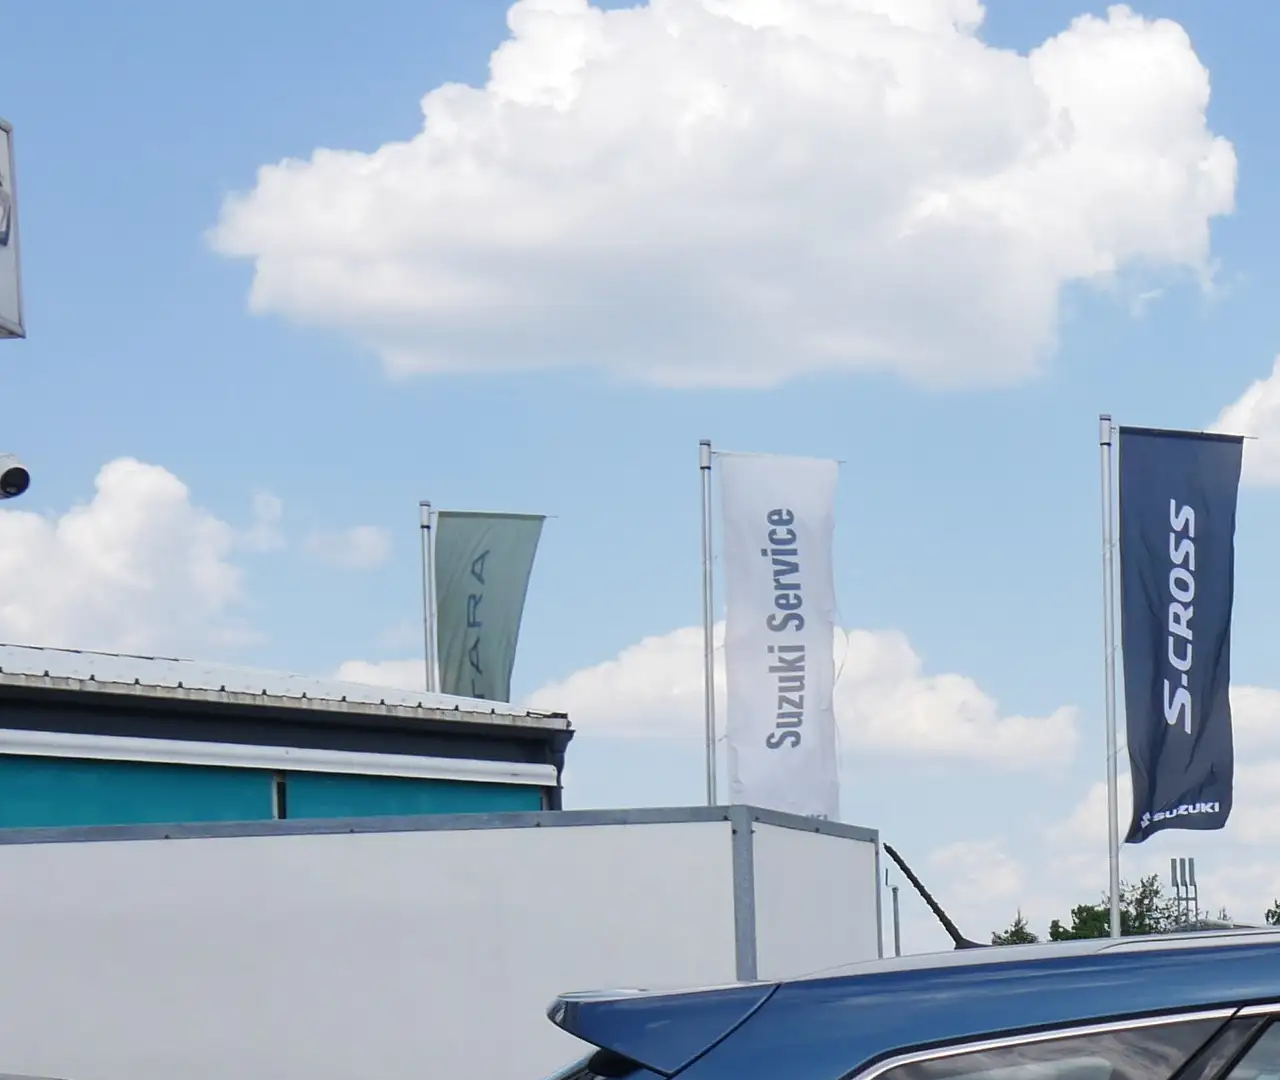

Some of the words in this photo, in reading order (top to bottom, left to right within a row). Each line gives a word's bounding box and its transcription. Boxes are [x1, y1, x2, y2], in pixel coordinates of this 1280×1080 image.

[760, 508, 806, 632] Service
[1163, 498, 1195, 735] S-CROSS
[765, 645, 806, 750] Suzuki
[1152, 802, 1220, 822] SUZUKI
